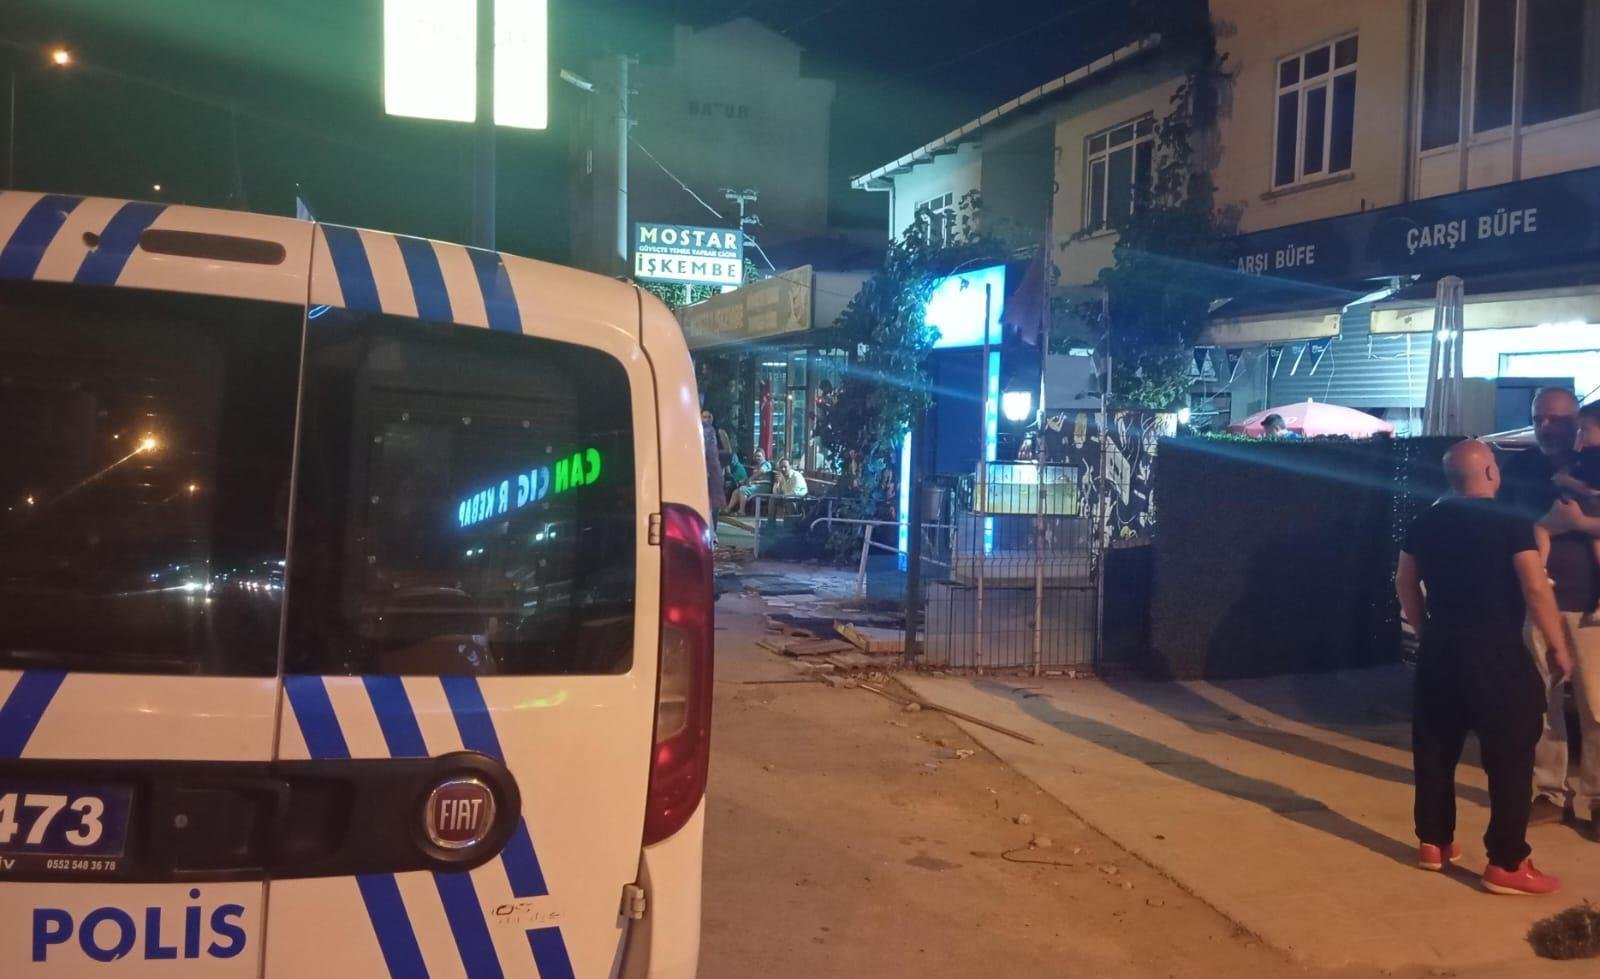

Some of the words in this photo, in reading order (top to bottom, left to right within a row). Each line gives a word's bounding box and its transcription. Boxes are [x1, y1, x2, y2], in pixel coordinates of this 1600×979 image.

[640, 227, 737, 250] MOSTAR
[1407, 219, 1466, 255] ÇARŞI
[1478, 208, 1538, 240] BÜFE
[638, 254, 737, 277] İŞKEMBE
[1231, 252, 1268, 277] ARŞI
[1275, 244, 1315, 269] BÜFE
[439, 799, 483, 831] FIAT
[47, 859, 70, 869] 0552
[32, 887, 247, 962] POLİS
